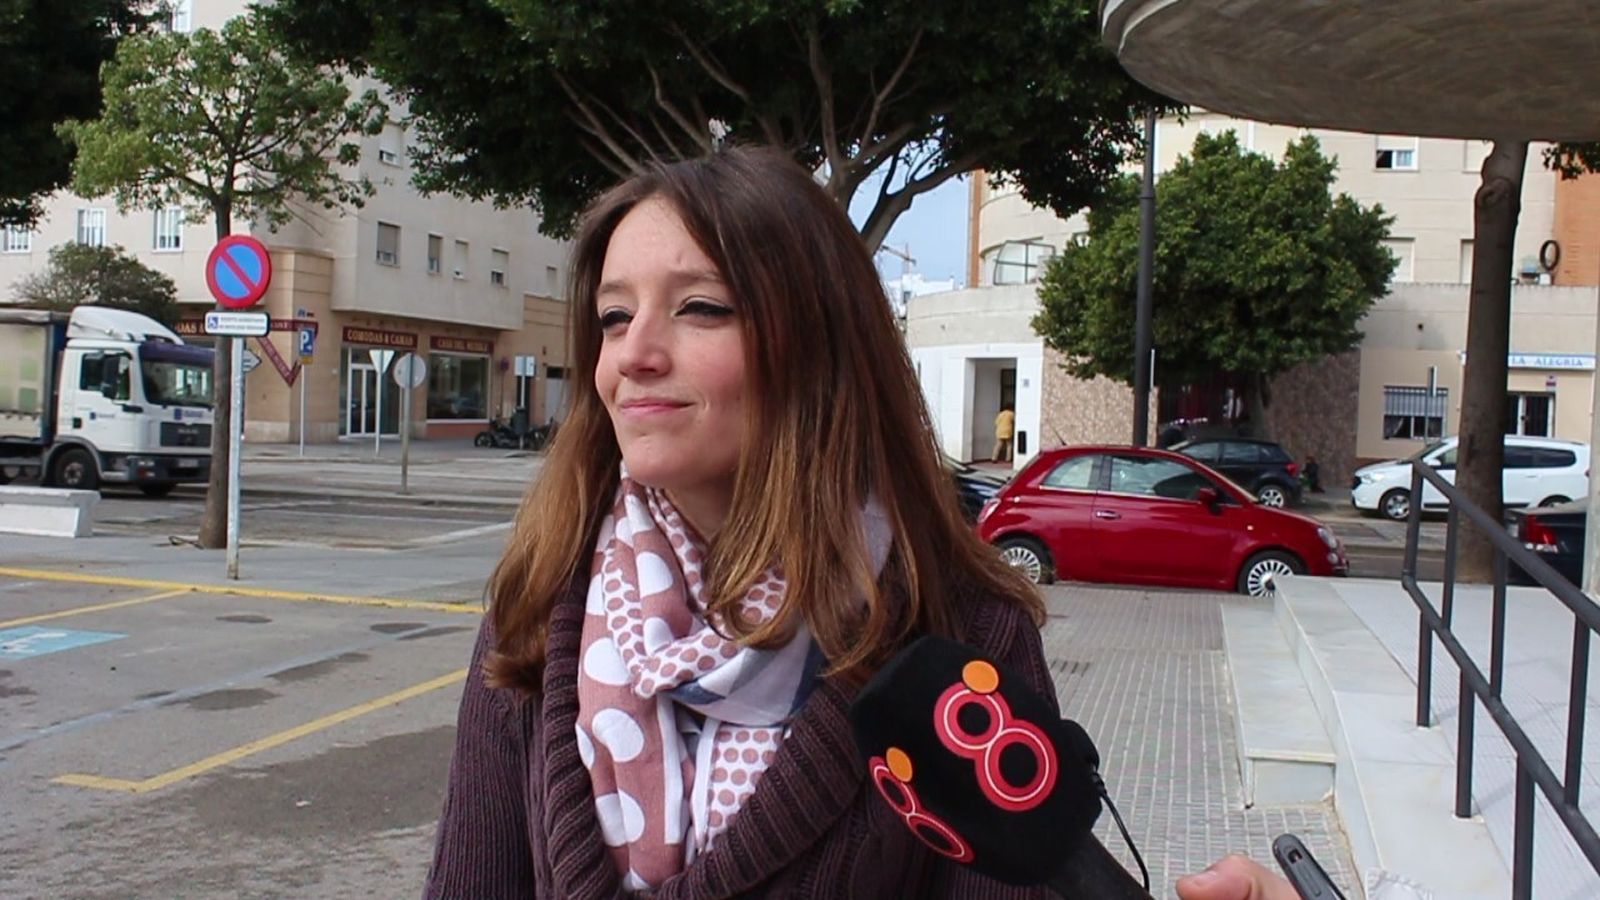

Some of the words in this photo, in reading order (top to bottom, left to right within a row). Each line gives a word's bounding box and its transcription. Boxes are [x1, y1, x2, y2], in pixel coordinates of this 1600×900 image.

[300, 330, 310, 352] P
[347, 328, 383, 343] COMODAS
[1512, 357, 1525, 365] LA
